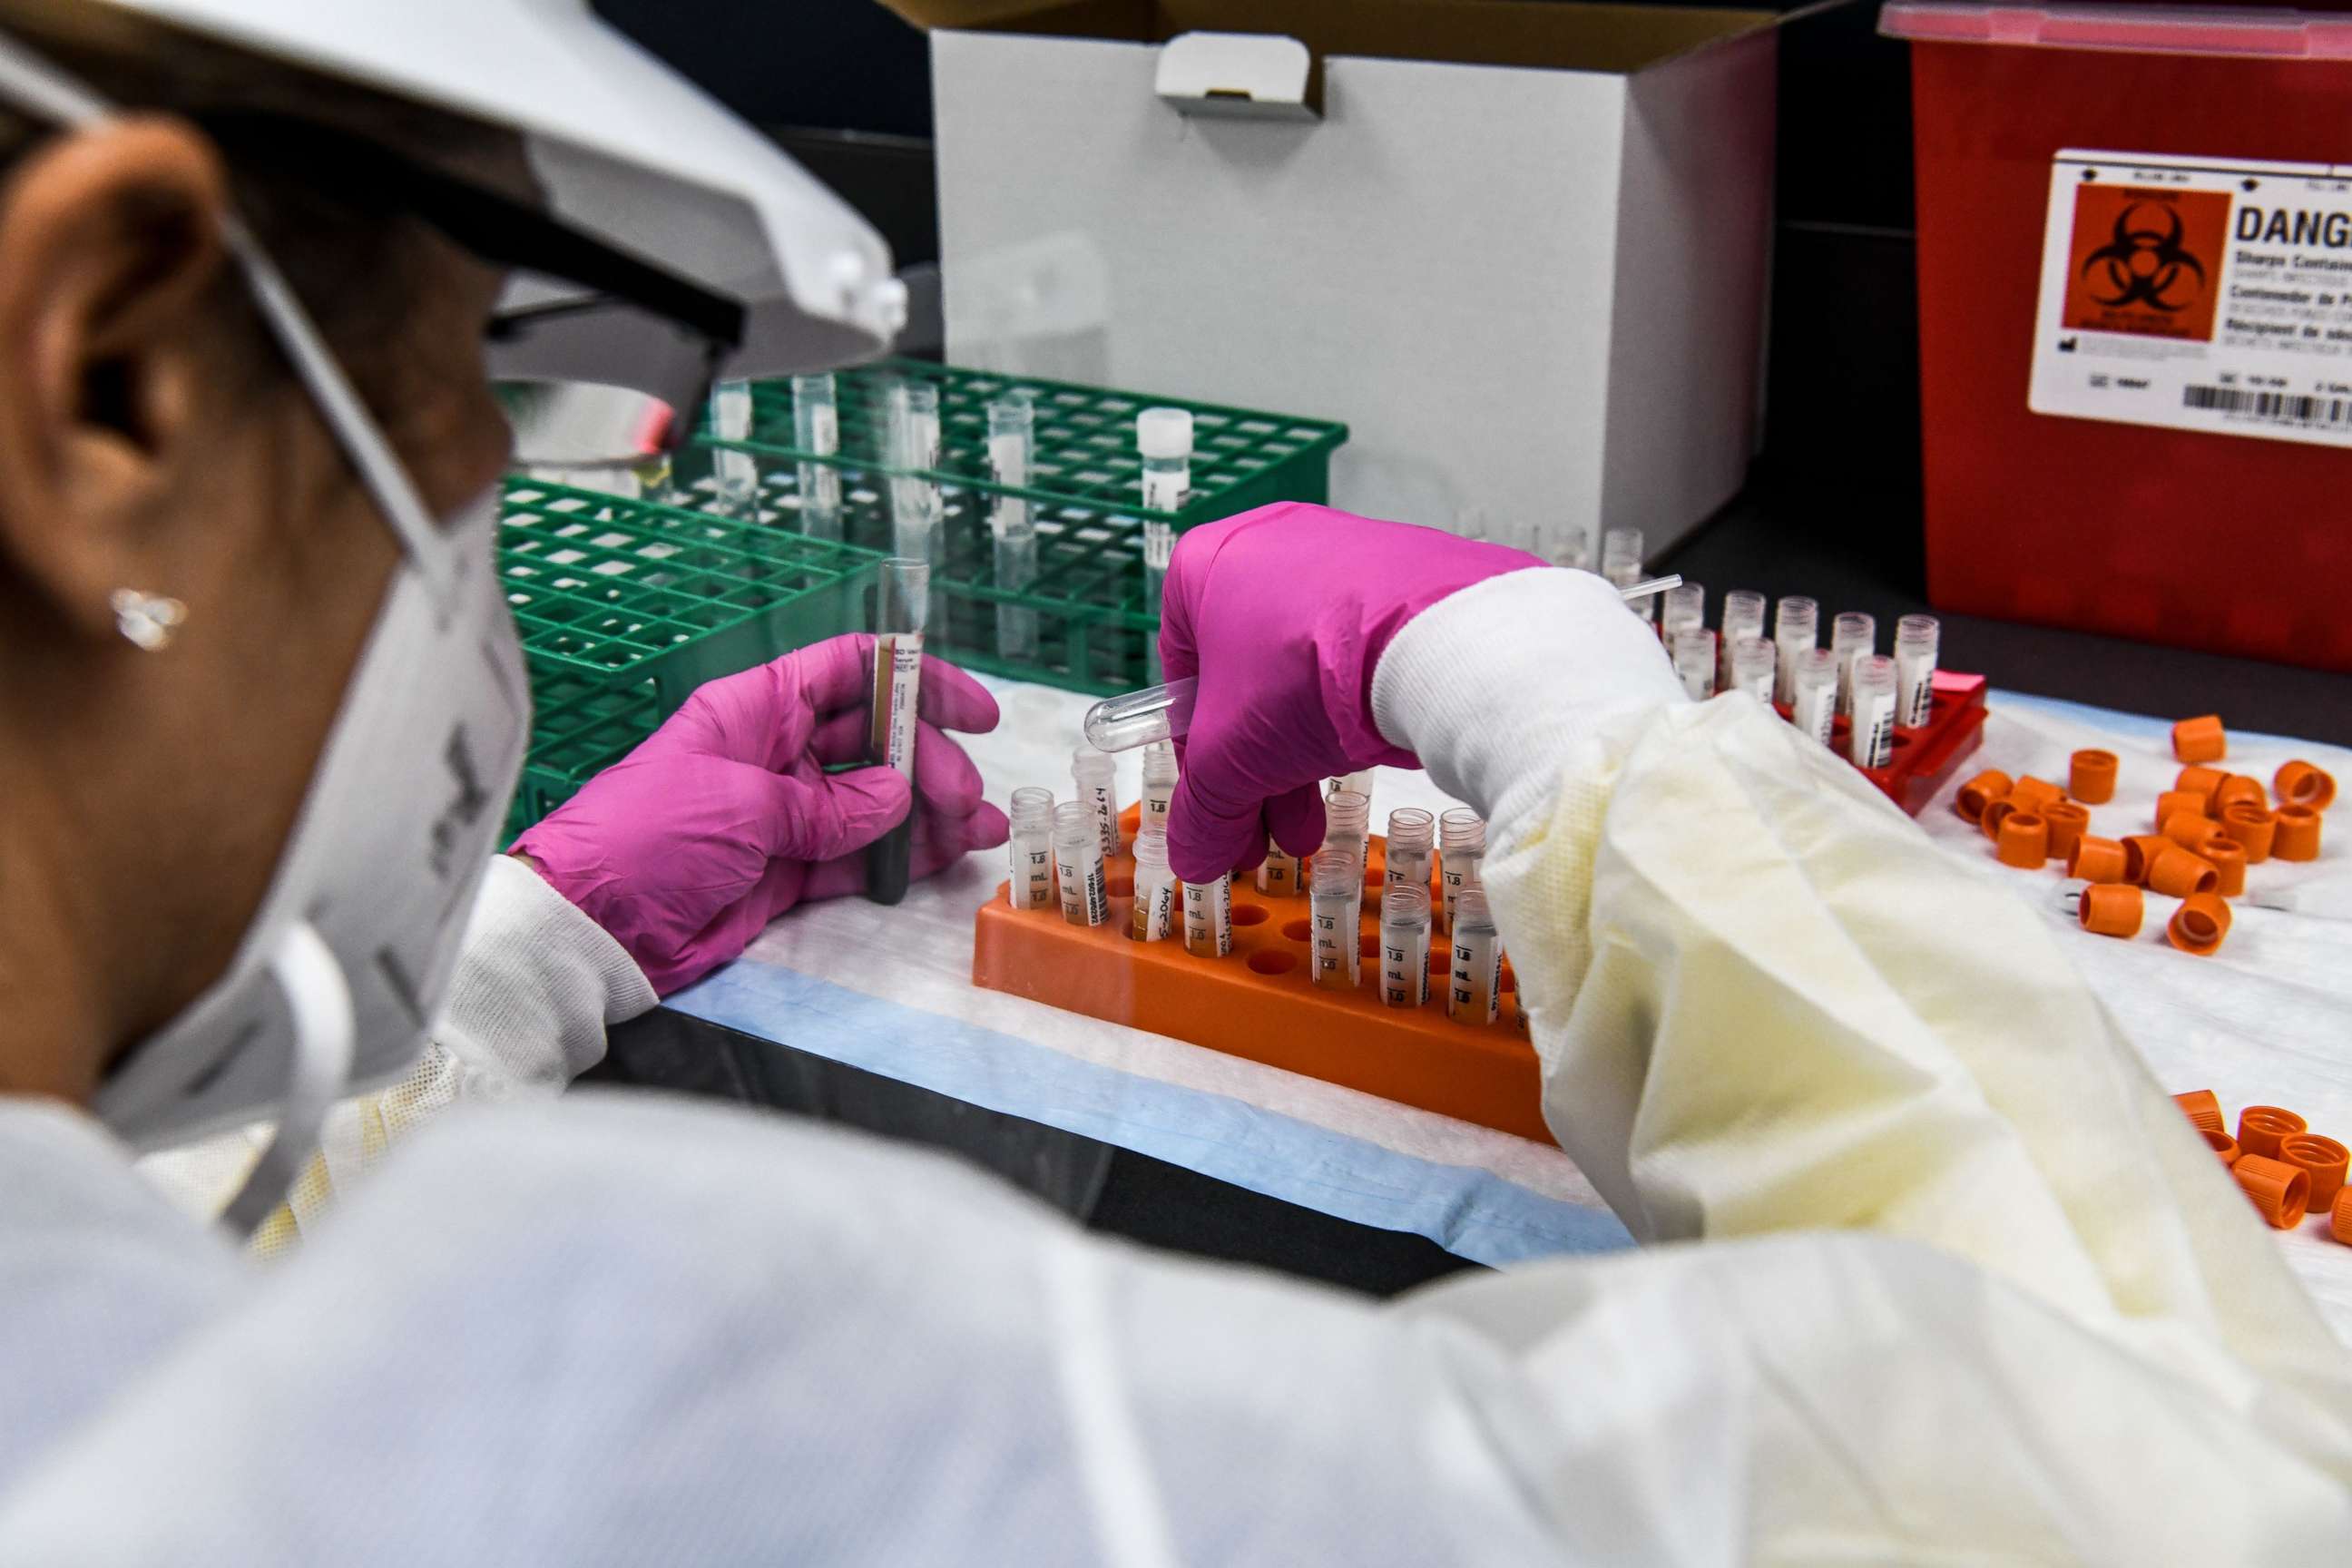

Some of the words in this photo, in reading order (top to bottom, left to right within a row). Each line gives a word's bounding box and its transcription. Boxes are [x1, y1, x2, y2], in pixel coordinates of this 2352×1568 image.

[2236, 206, 2352, 248] DANG
[2294, 255, 2352, 271] Contain
[1150, 803, 1166, 813] 1.8
[1031, 855, 1046, 865] 1.8
[1031, 872, 1047, 881] mL
[1060, 867, 1073, 877] 1.8
[1269, 870, 1283, 880] 1.0
[1446, 875, 1461, 887] 1.8
[1188, 890, 1202, 902] 1.8
[1189, 910, 1205, 920] mL
[1318, 918, 1334, 930] 1.8
[1318, 938, 1336, 949] mL
[1387, 950, 1403, 962] 1.8
[1455, 948, 1471, 961] 1.8
[1387, 970, 1406, 981] mL
[1455, 969, 1472, 982] mL
